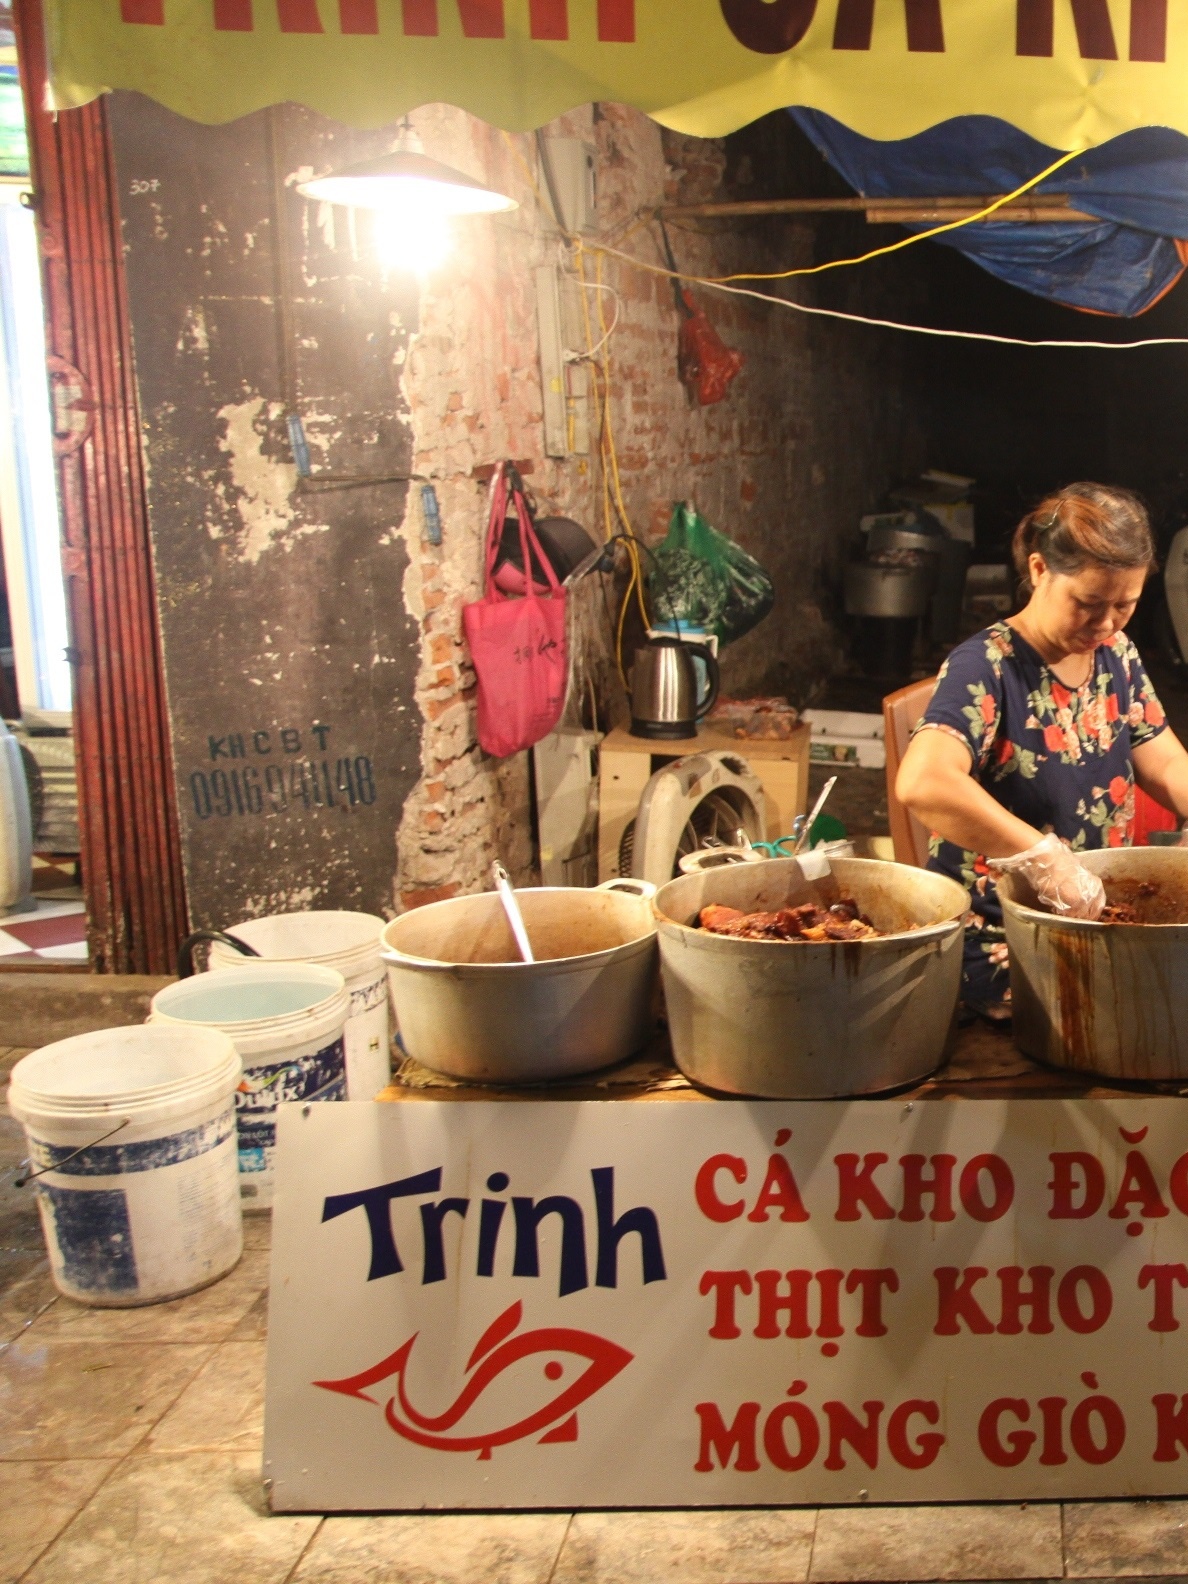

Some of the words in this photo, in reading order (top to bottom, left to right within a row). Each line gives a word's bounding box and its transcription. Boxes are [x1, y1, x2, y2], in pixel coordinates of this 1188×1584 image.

[695, 1128, 811, 1223] CÁ
[834, 1152, 1015, 1223] KHO
[321, 1166, 668, 1298] Trinh
[698, 1267, 899, 1358] THỊT
[933, 1265, 1114, 1336] KHO
[694, 1379, 946, 1473] MÓNG
[977, 1371, 1126, 1468] GIÒ
